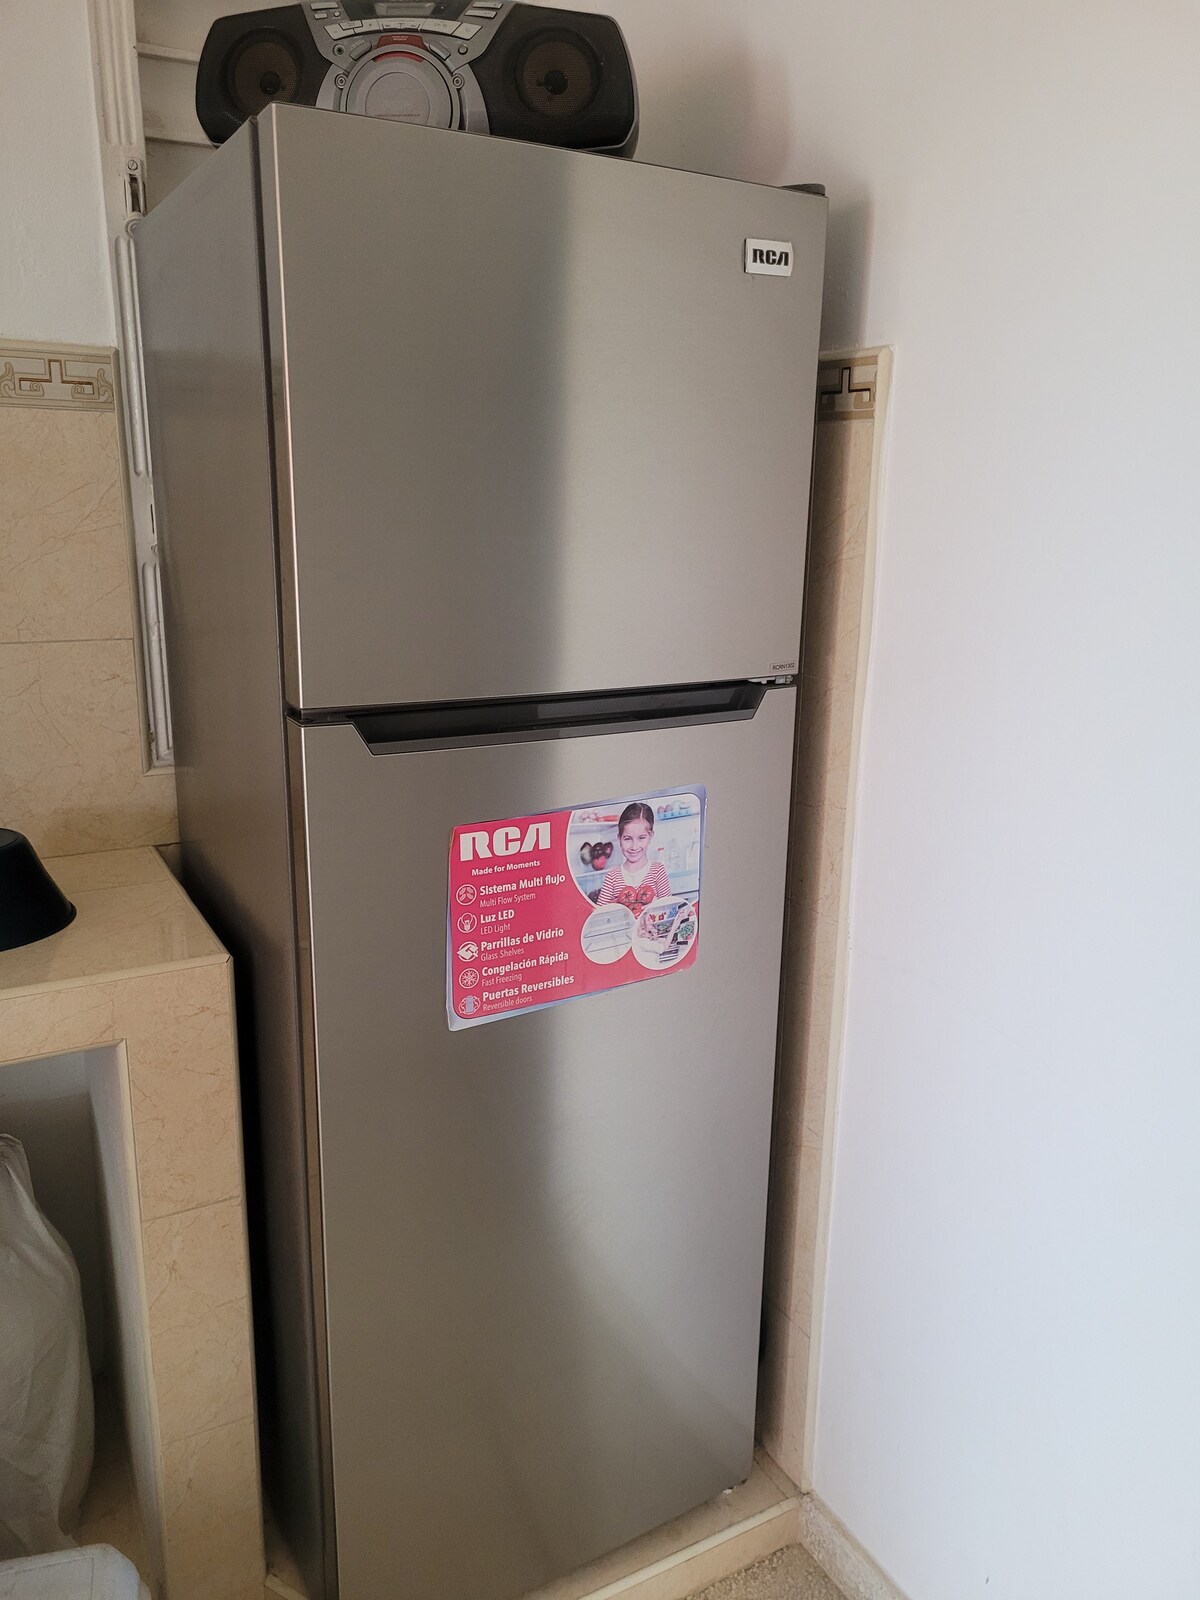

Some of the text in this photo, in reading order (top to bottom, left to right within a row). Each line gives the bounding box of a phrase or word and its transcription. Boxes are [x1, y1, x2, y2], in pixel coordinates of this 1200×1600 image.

[752, 248, 789, 266] RCA
[459, 821, 551, 862] RCA
[471, 860, 541, 877] Made for Moments
[479, 873, 566, 896] Sistema Multi flujo
[479, 892, 536, 908] Multi Flow System
[480, 909, 515, 924] Luz LED
[480, 923, 511, 935] LED Light
[480, 927, 564, 951] Parrillas de Vidrio
[480, 947, 525, 962] Glass Shelves
[481, 951, 569, 976] Congelación Rápida
[481, 973, 523, 987] Fast Freezing
[482, 974, 574, 1001] Puertas Reversibles
[482, 994, 533, 1011] Reversible doors
